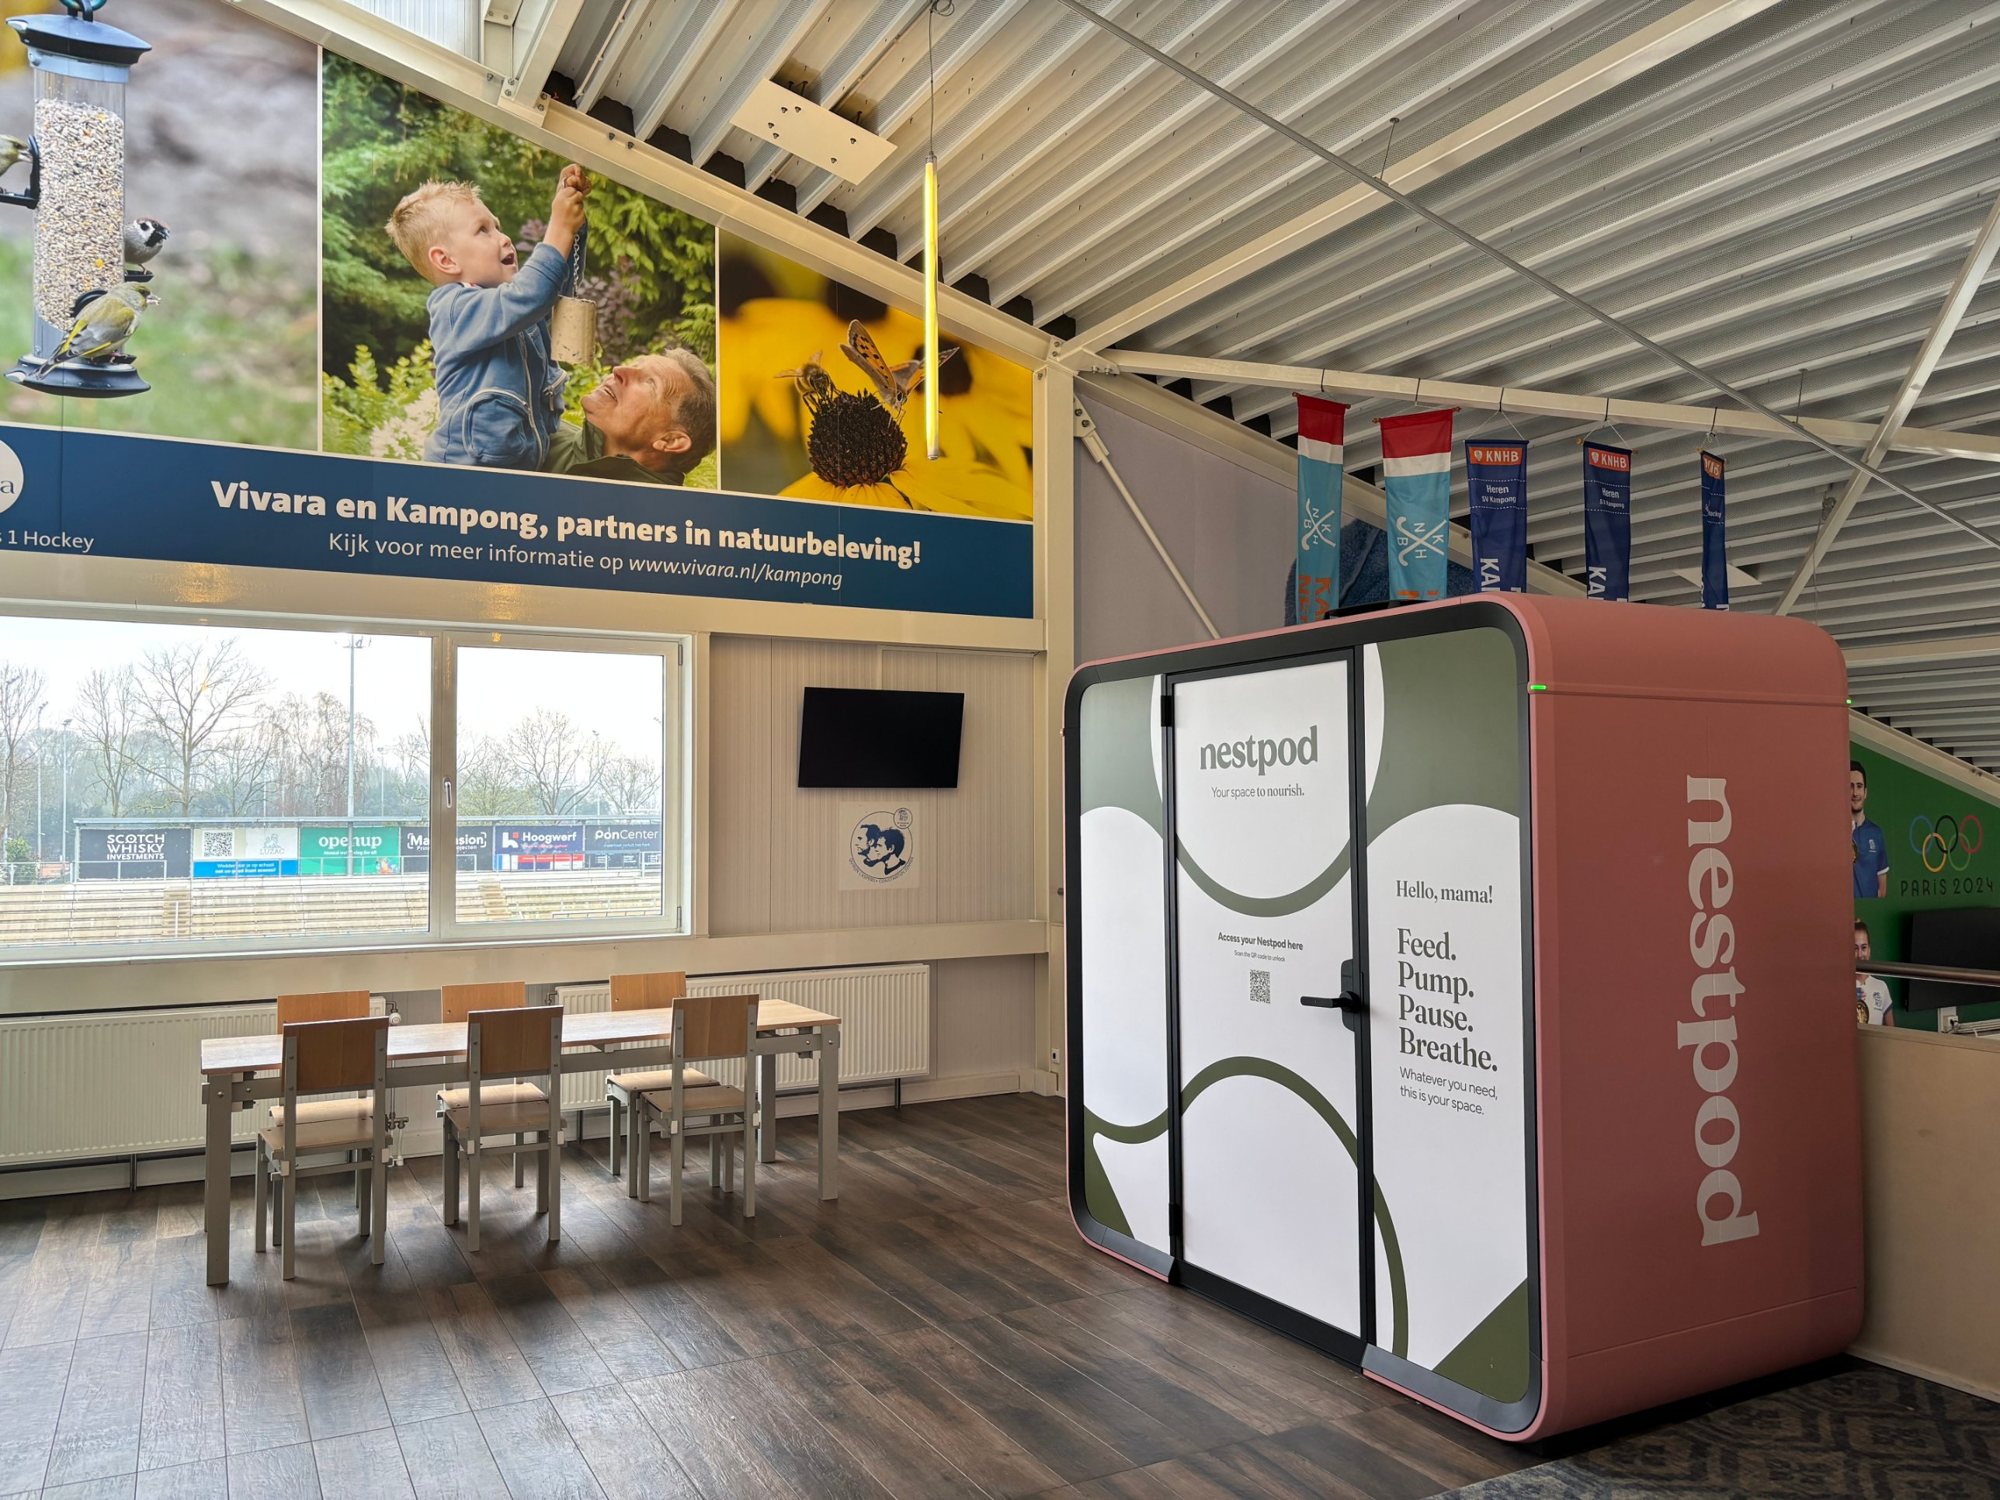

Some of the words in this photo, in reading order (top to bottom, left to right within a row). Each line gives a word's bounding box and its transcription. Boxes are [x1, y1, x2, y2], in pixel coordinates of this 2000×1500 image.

[1486, 450, 1519, 462] KNHB
[1601, 455, 1628, 469] KNHB
[1486, 484, 1509, 494] Heren
[211, 480, 326, 516] Vivara
[336, 498, 377, 520] en
[387, 496, 548, 540] Kampong,
[557, 515, 678, 543] partners
[685, 519, 711, 546] in
[719, 531, 921, 570] natuurbeleving!
[8, 530, 18, 545] 1
[23, 530, 95, 554] Hockey
[329, 533, 369, 558] Kijk
[375, 539, 423, 556] voor
[430, 543, 482, 560] meer
[489, 543, 594, 568] informatie
[599, 555, 623, 575] op
[629, 558, 843, 591] www.vivara.nl/kampong
[1480, 558, 1501, 592] KA
[1588, 566, 1607, 601] KA
[1200, 724, 1318, 776] nestpod
[1211, 786, 1229, 798] Your
[1231, 787, 1256, 800] space
[1257, 787, 1266, 797] to
[1267, 783, 1305, 797] nourish.
[107, 834, 165, 844] SCOTCH
[107, 844, 165, 853] WHISKY
[522, 832, 577, 844] Hoogwerf
[107, 852, 165, 860] INVESTMENTS
[1396, 880, 1439, 903] Hello,
[1441, 885, 1493, 904] mama!
[1953, 877, 1994, 895] 2024
[1218, 932, 1240, 943] Access
[1240, 936, 1256, 946] your
[1256, 936, 1286, 949] Nestpod
[1287, 940, 1304, 951] here
[1397, 928, 1457, 961] Feed.
[1272, 954, 1286, 962] unlock
[1398, 961, 1474, 1004] Pump.
[1398, 994, 1474, 1032] Pause.
[1677, 775, 1760, 1247] nestpod
[1399, 1026, 1498, 1072] Breathe.
[1399, 1065, 1447, 1088] Whatever
[1447, 1078, 1467, 1092] you
[1469, 1081, 1498, 1100] need,
[1400, 1085, 1417, 1100] this
[1418, 1090, 1427, 1102] is
[1427, 1092, 1450, 1106] your
[1451, 1098, 1485, 1115] space.
